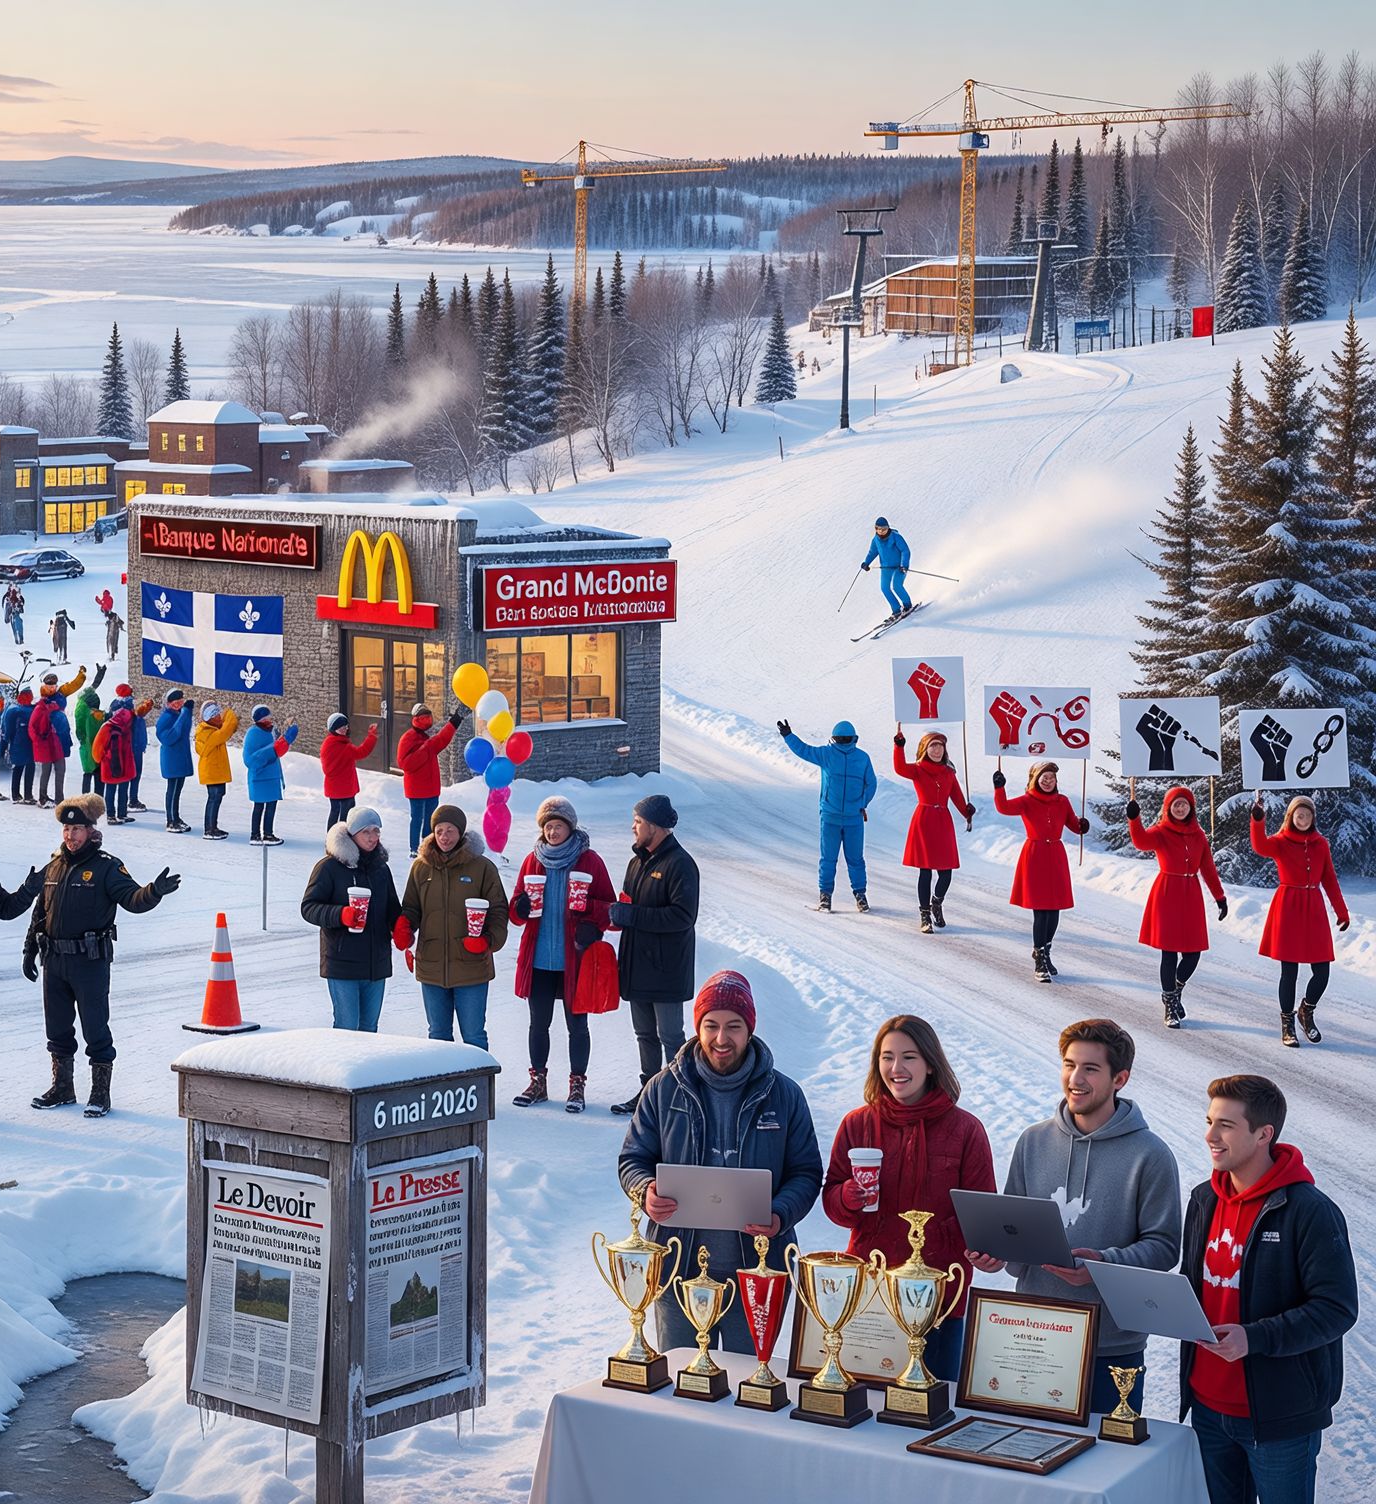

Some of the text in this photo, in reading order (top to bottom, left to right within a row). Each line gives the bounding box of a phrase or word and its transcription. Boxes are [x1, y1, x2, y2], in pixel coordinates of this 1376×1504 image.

[496, 572, 567, 600] Grand
[374, 1085, 478, 1129] 6 mai 2026
[217, 1176, 316, 1219] Le Devoir
